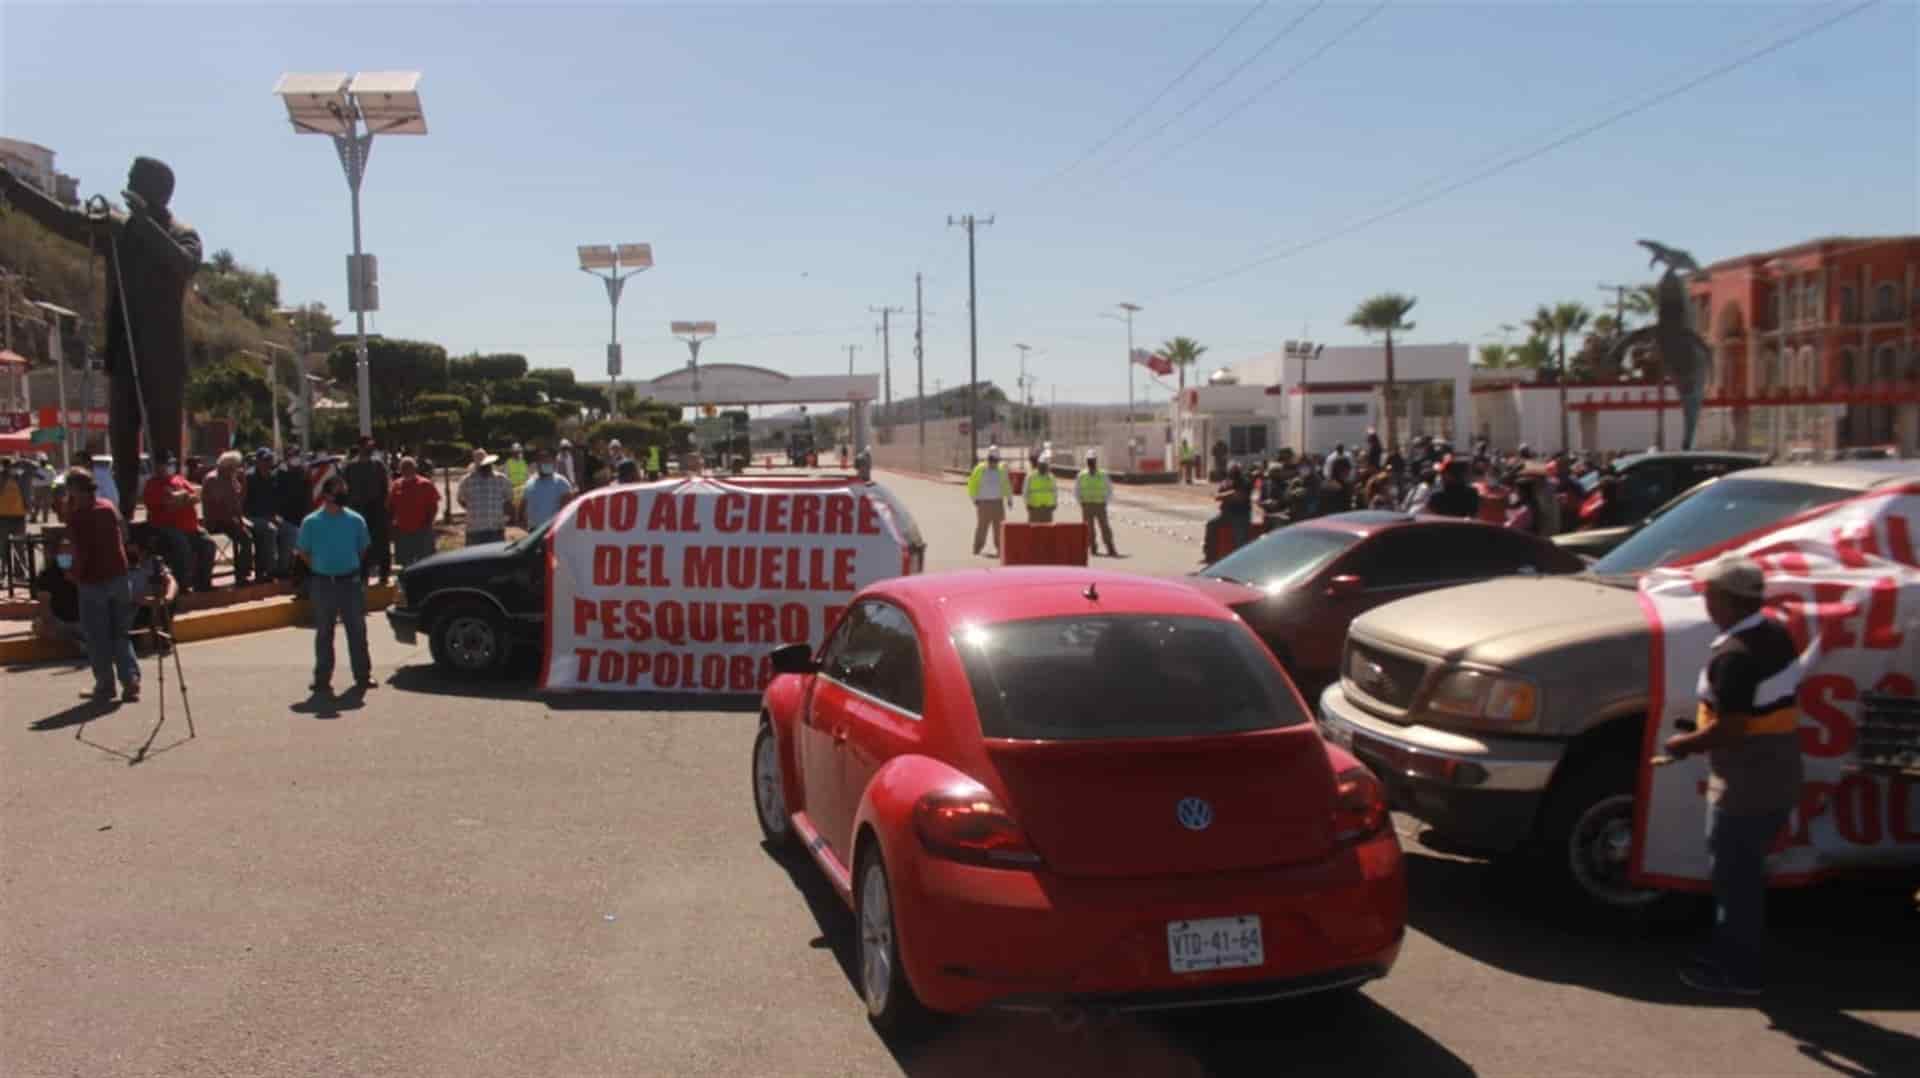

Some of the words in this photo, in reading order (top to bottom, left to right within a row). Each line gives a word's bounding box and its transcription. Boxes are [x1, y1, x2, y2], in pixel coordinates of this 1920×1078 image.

[575, 493, 639, 532] NO
[647, 493, 701, 533] AL
[713, 494, 881, 535] CIERRE
[592, 544, 672, 588] DEL
[682, 545, 857, 592] MUELLE
[573, 598, 811, 645] PESQUERO
